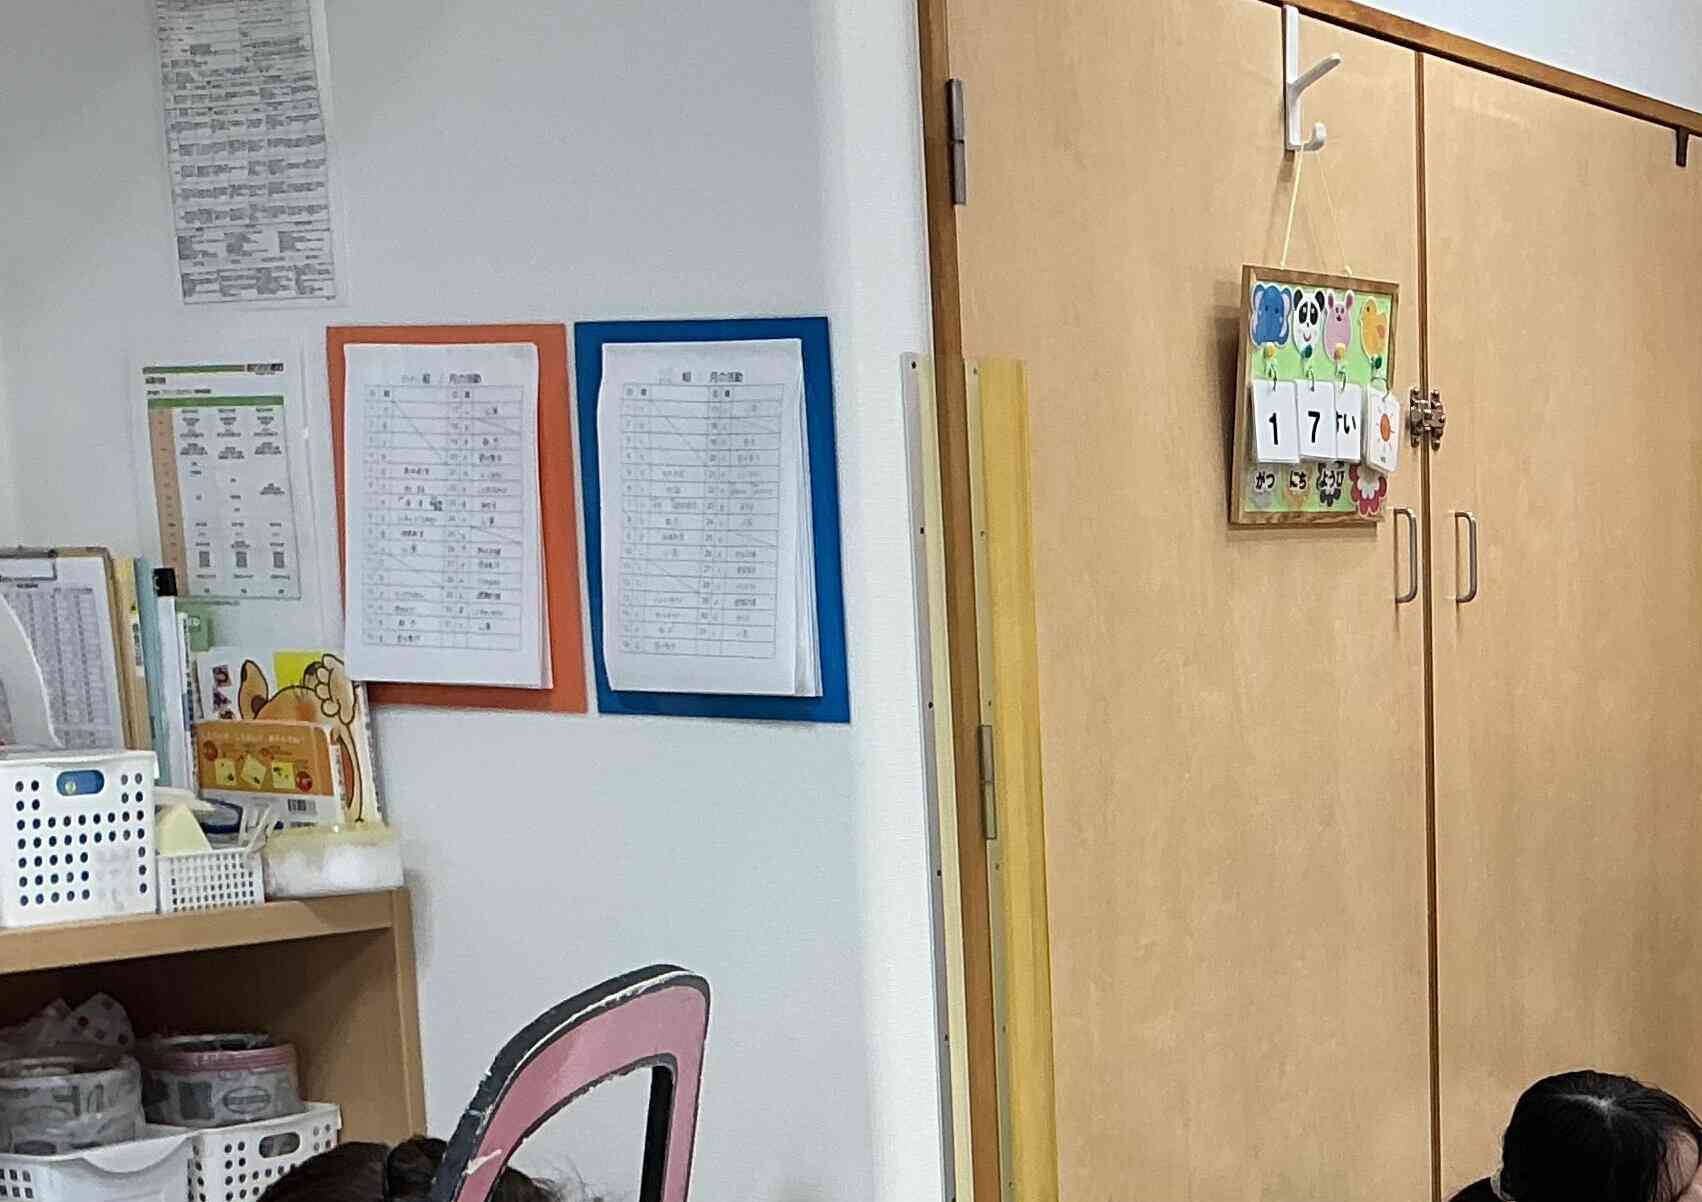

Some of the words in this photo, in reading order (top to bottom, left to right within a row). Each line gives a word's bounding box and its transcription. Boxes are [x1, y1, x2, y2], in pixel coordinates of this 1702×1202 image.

[1268, 411, 1279, 446] 1
[1307, 411, 1321, 443] 7
[1255, 471, 1276, 490] がつ
[1290, 470, 1308, 490] にち
